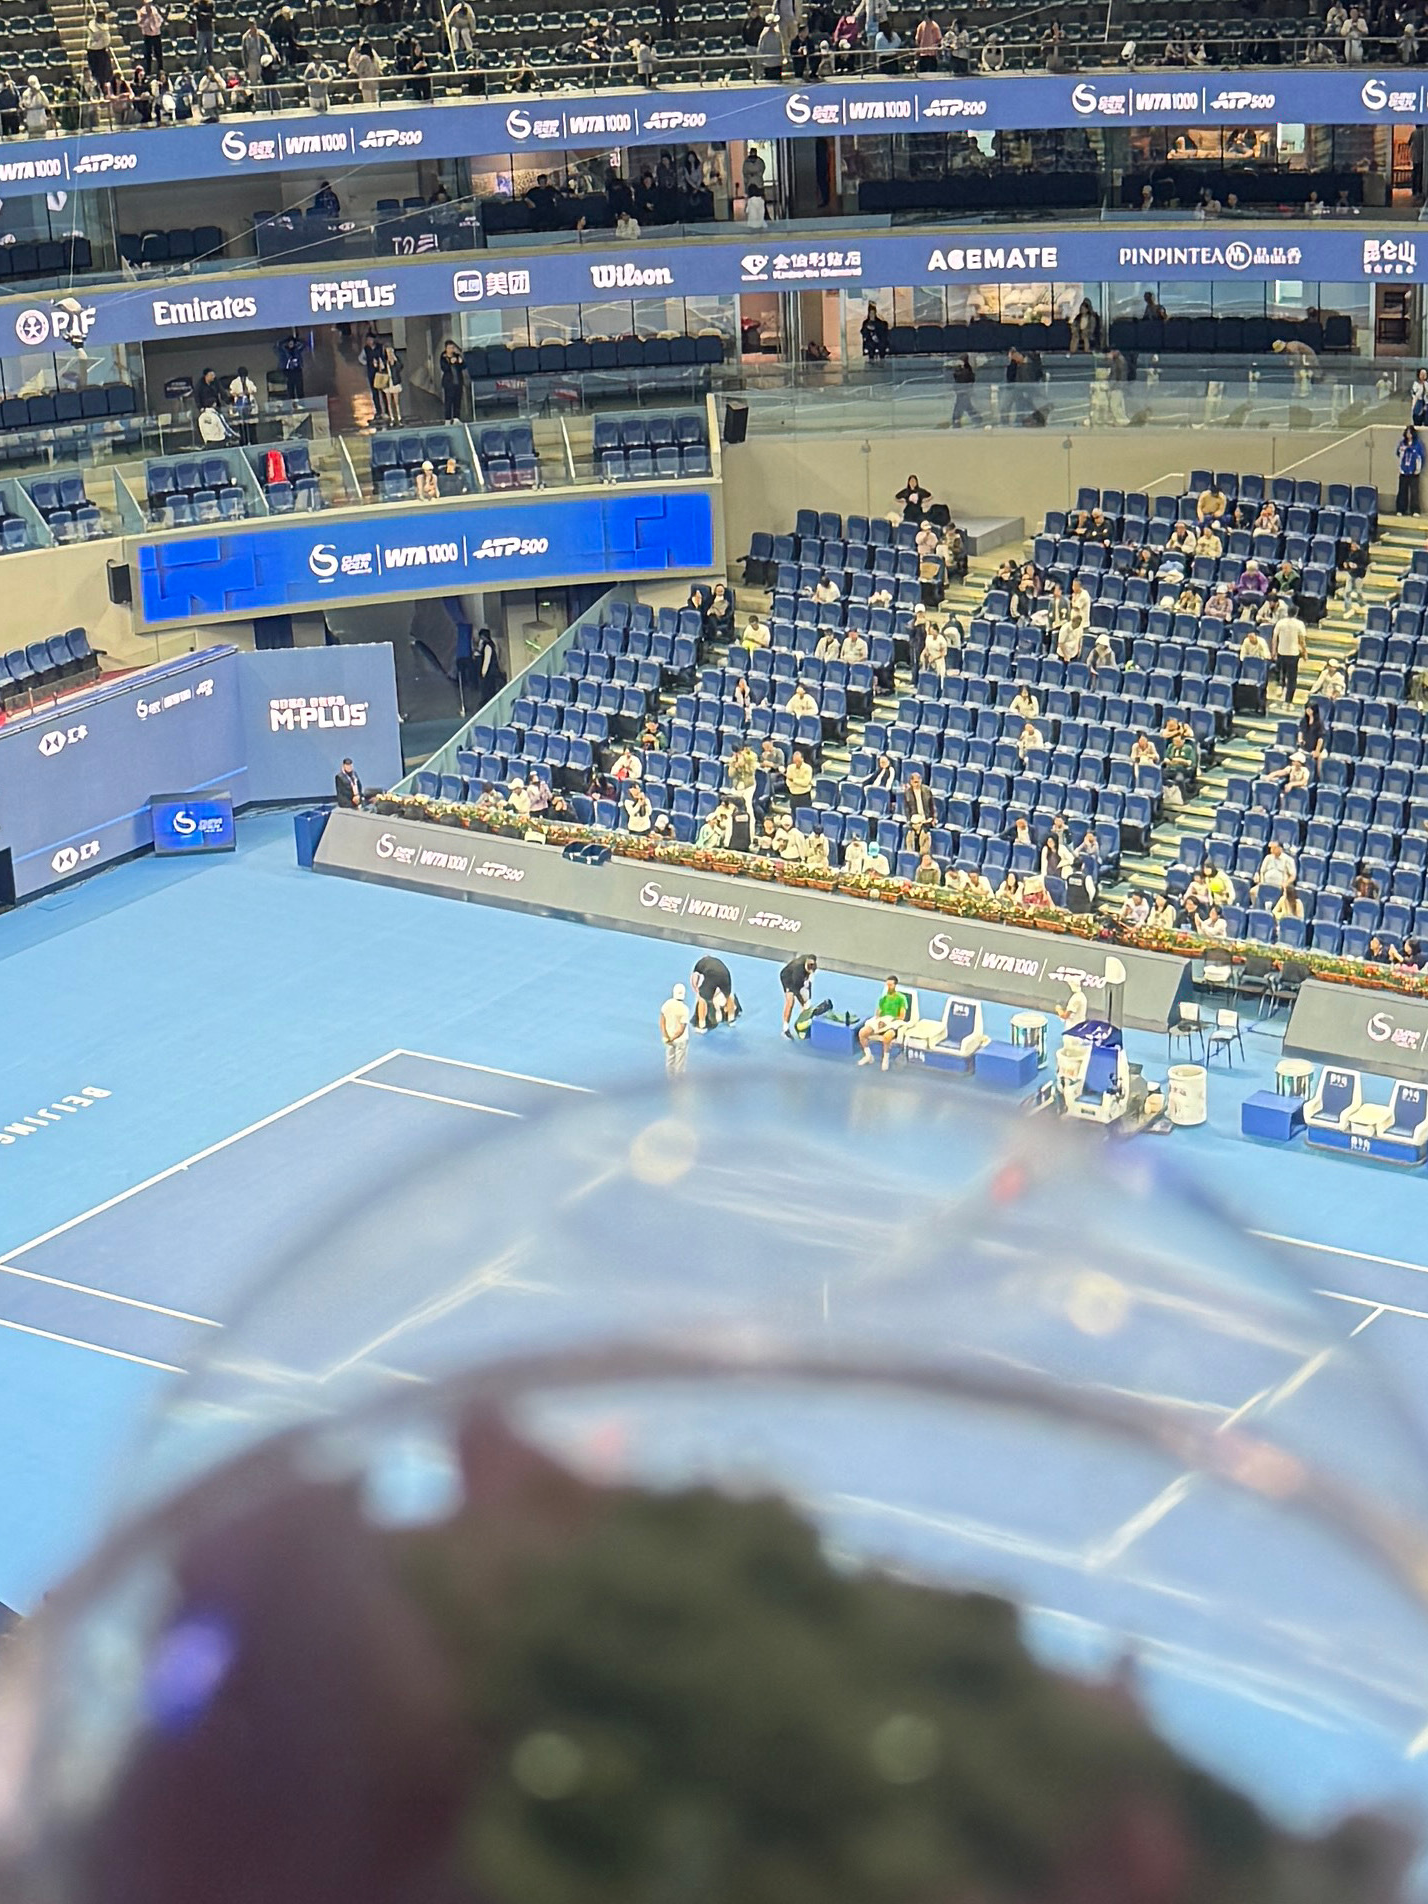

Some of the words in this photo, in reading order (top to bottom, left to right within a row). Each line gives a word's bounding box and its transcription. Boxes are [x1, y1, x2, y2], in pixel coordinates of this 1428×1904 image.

[928, 248, 1057, 270] ACEMATE
[1120, 248, 1224, 265] PINPINTEA
[485, 271, 529, 296] 美团
[590, 264, 674, 288] Wilson
[153, 297, 256, 325] Emirates
